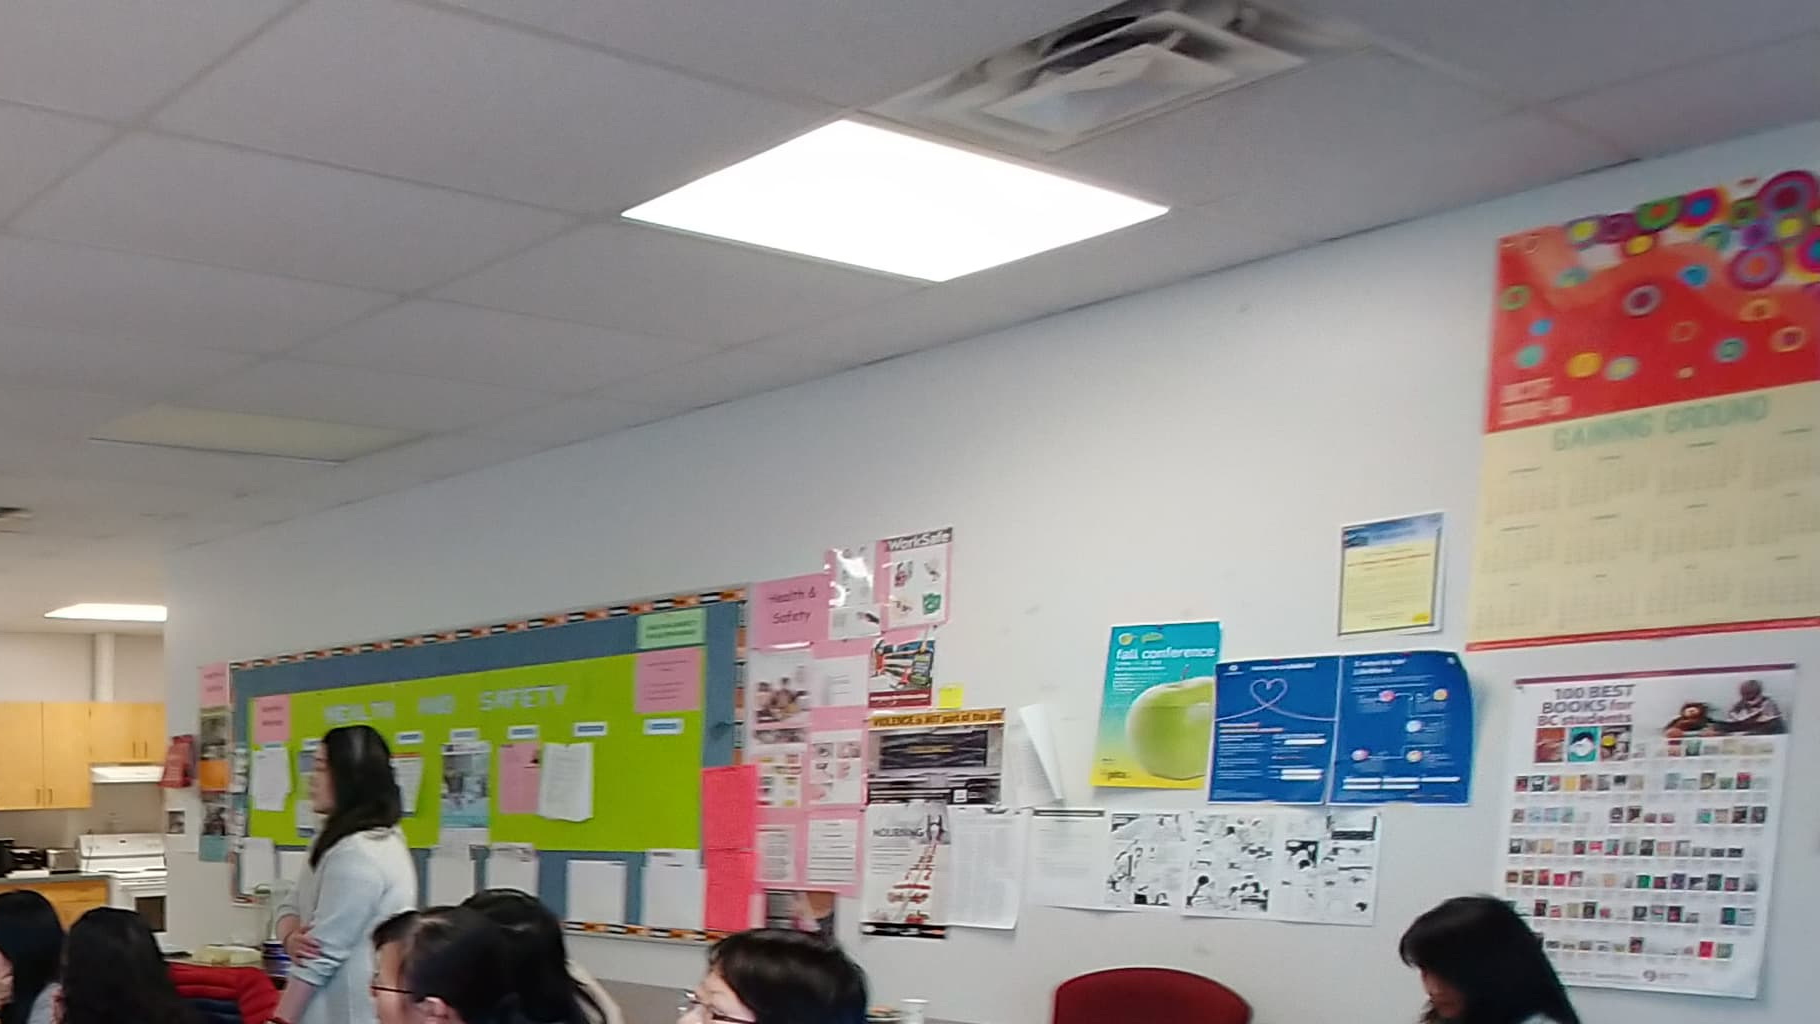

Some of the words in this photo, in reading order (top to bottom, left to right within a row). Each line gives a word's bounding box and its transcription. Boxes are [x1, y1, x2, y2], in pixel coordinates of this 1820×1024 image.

[1665, 395, 1771, 434] GROUND
[887, 531, 950, 551] WorkSafe
[769, 590, 805, 603] Health
[772, 610, 811, 625] Safety
[1116, 648, 1138, 660] fall
[1141, 646, 1216, 660] conference
[481, 685, 568, 711] SAFETY
[1554, 688, 1584, 700] 100
[1589, 684, 1636, 699] BEST
[1542, 699, 1606, 714] BOOKS
[1537, 715, 1559, 726] BC
[1561, 712, 1633, 725] students
